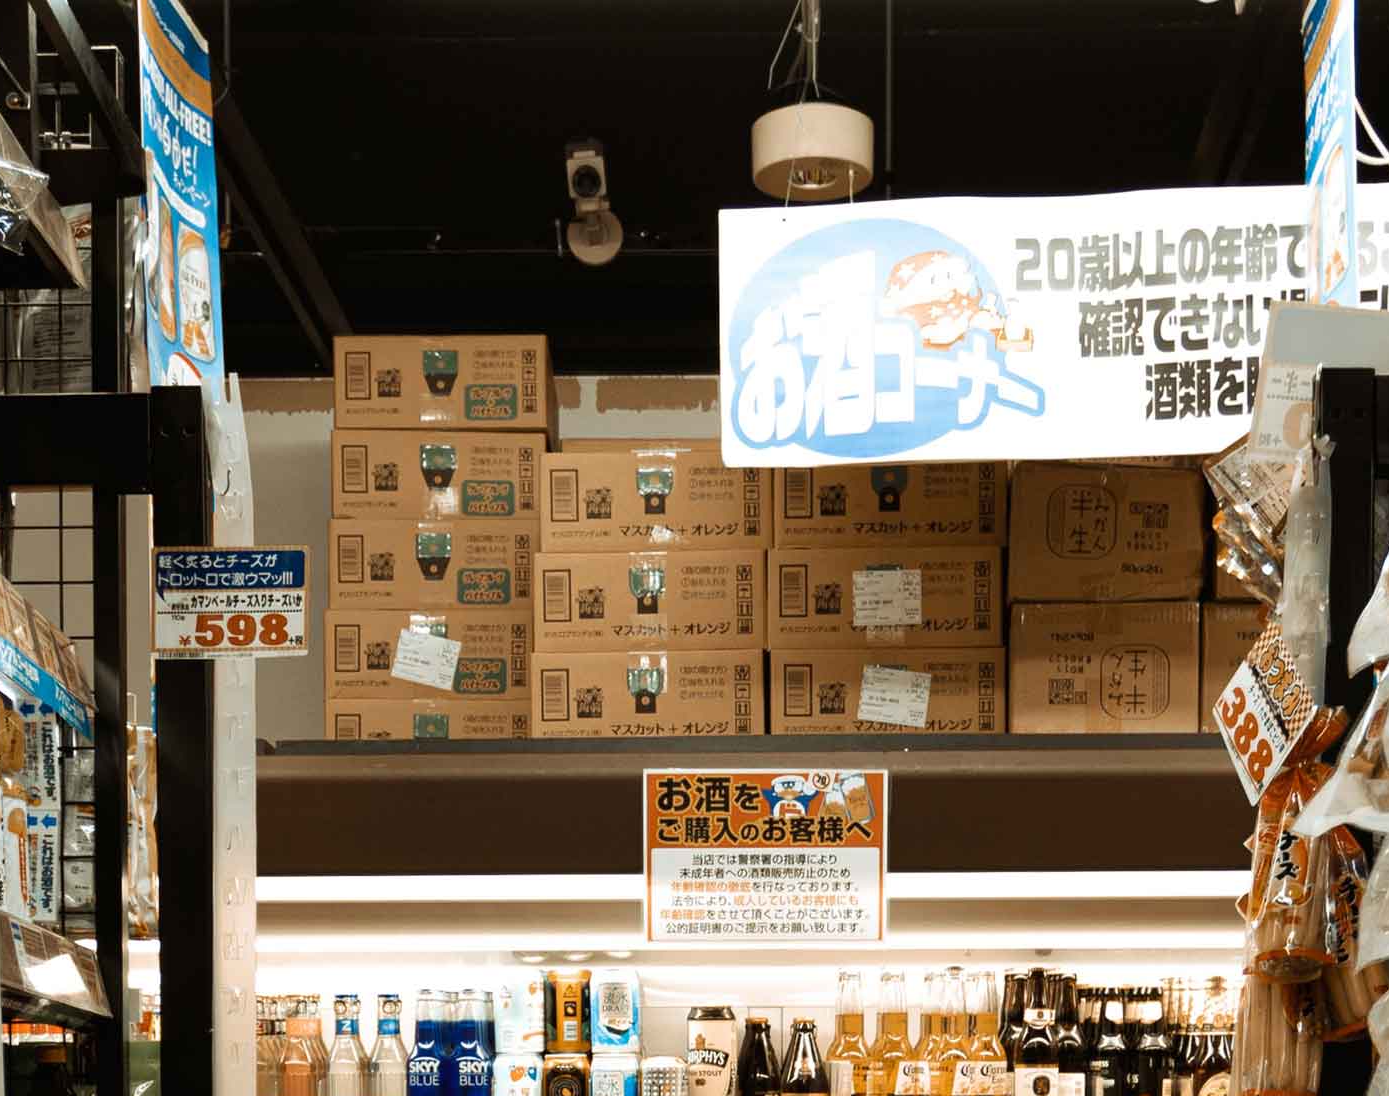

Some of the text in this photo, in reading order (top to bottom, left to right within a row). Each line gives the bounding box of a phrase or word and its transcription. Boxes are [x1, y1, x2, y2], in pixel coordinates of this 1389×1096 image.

[736, 250, 1043, 443] お酒コーナー
[158, 553, 278, 569] 軽く炙るとチーズが
[194, 613, 289, 648] 598
[656, 776, 761, 814] お酒を
[657, 817, 873, 844] ご購入のお客様へ
